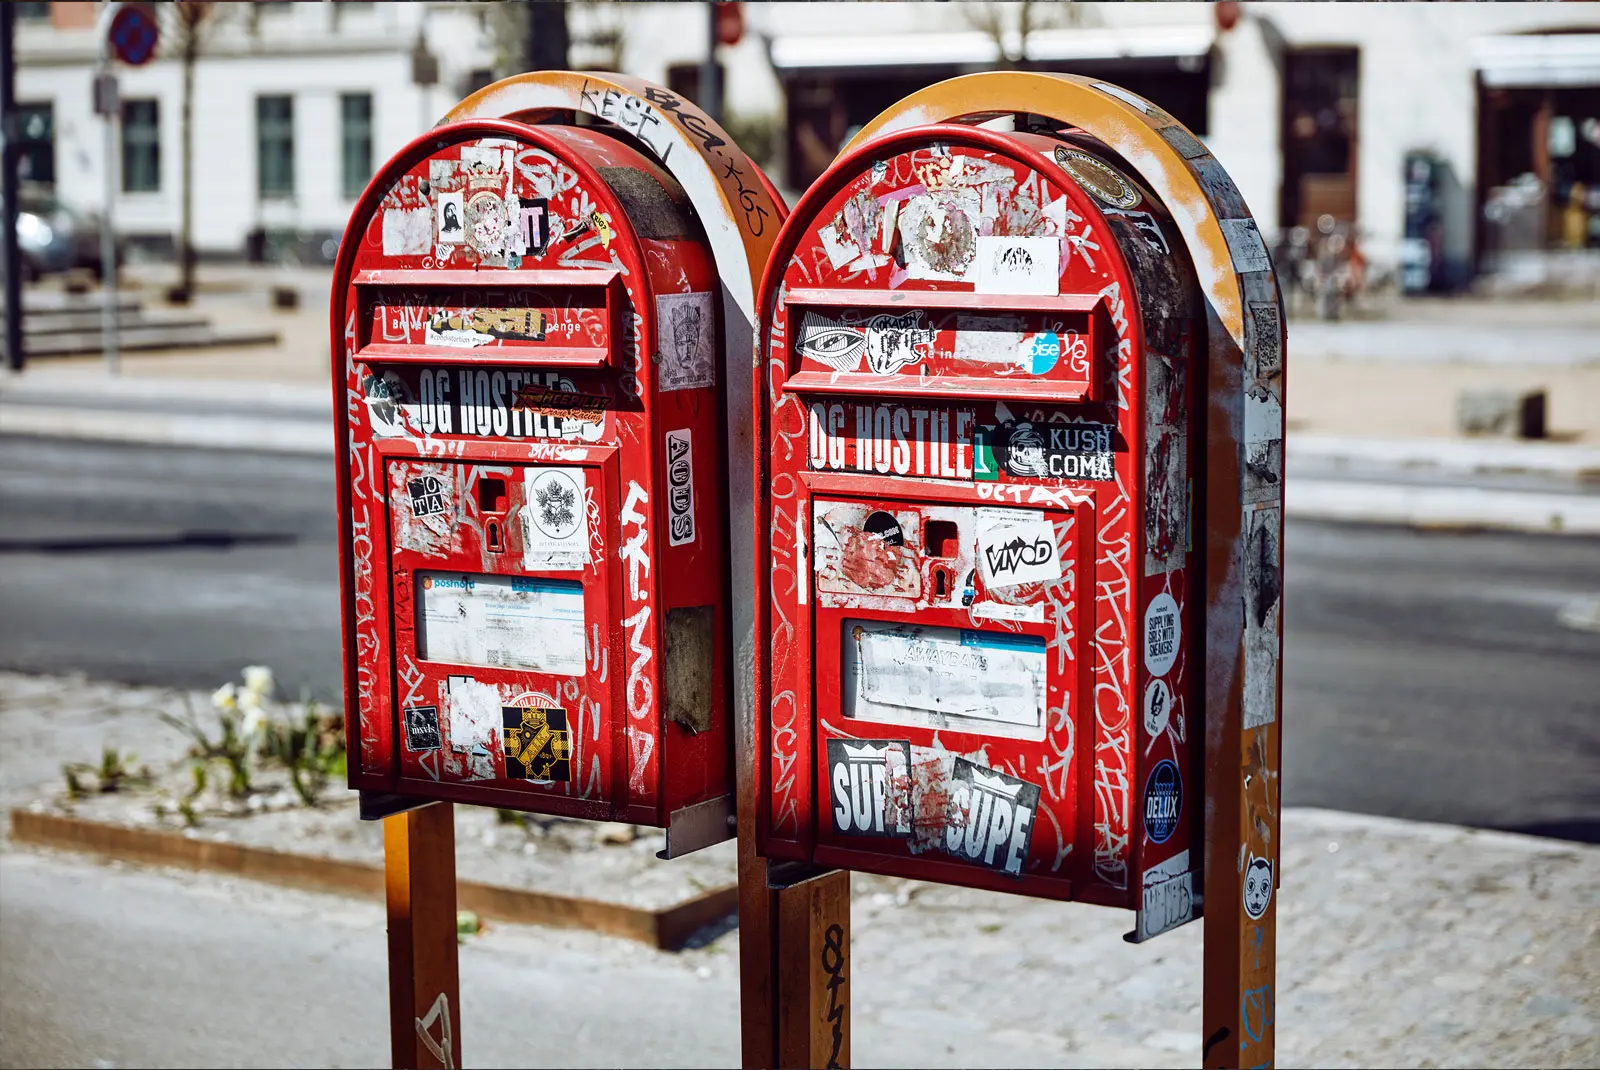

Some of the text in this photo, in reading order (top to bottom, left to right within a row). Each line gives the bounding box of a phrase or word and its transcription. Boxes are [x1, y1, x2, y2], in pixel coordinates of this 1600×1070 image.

[420, 369, 453, 435] OG
[458, 370, 563, 438] HOSTILE
[810, 402, 973, 478] OG HOSTILE
[1050, 428, 1111, 451] KUSH
[1049, 455, 1113, 478] COMA
[434, 578, 475, 589] postnord
[1149, 613, 1175, 631] SUPPLYING
[1149, 626, 1175, 645] GIRLS WITH
[1149, 640, 1174, 658] SNEAKERS
[1146, 796, 1178, 818] DELUX
